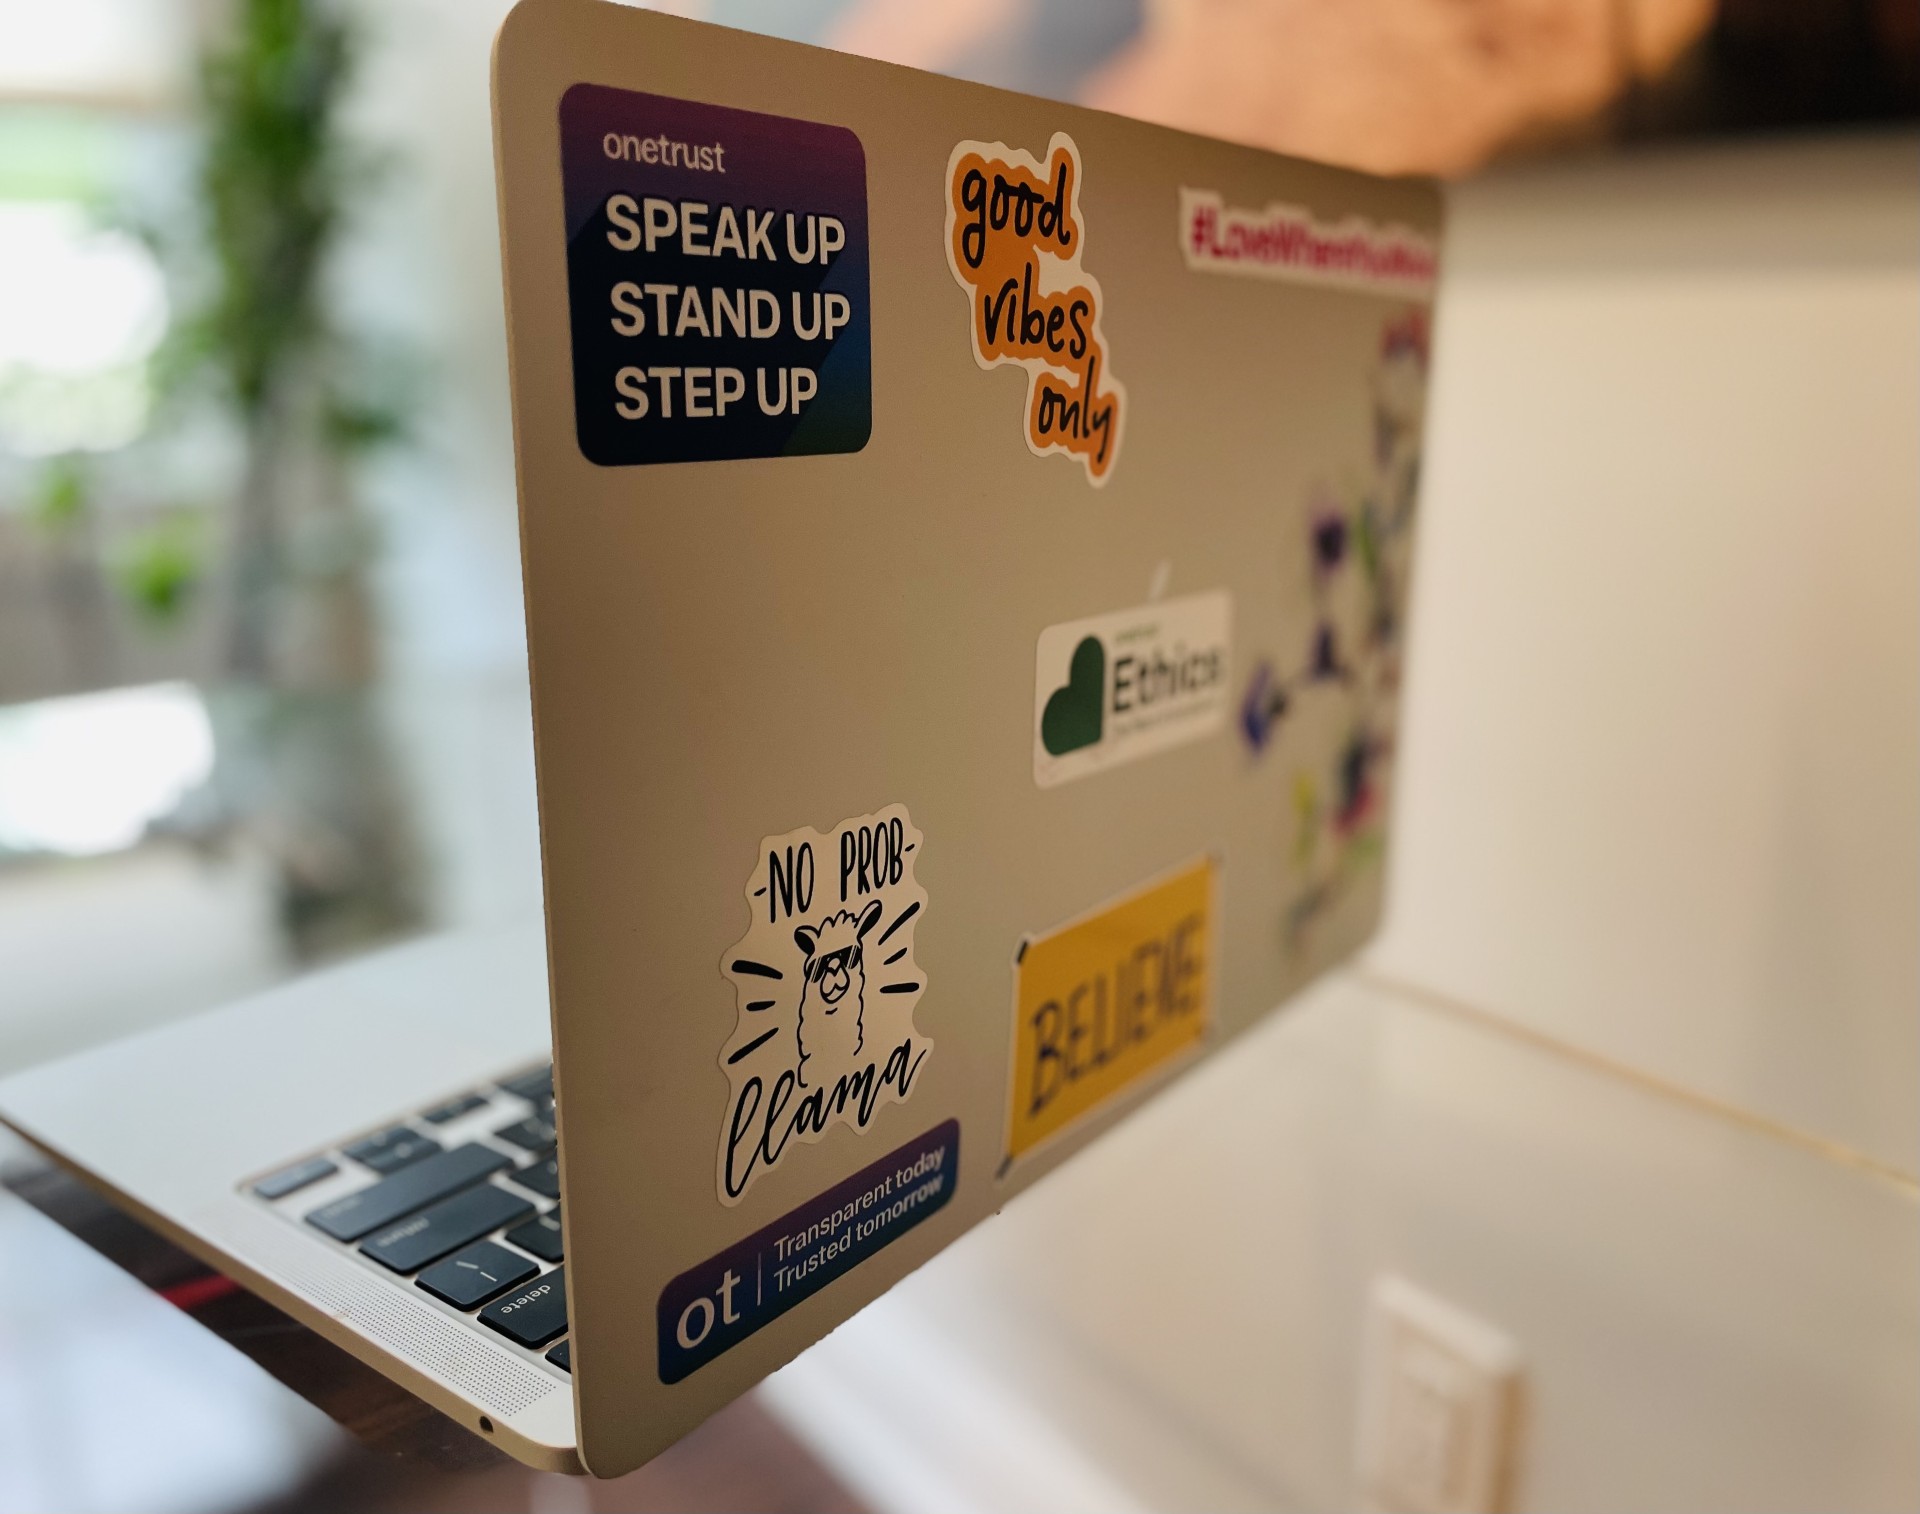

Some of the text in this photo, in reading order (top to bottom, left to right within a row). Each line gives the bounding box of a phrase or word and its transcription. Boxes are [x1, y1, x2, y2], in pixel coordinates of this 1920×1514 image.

[603, 132, 726, 174] onetrust
[605, 194, 846, 265] SPEAK UP
[962, 162, 1071, 269] good
[610, 281, 851, 340] STAND UP
[984, 262, 1089, 360] vibes
[614, 366, 818, 420] STEP UP
[1038, 355, 1112, 464] only
[1028, 911, 1206, 1120] BELIEVE
[725, 1038, 927, 1198] llama
[774, 1145, 945, 1262] Transparent today
[774, 1174, 944, 1293] Trusted tomorrow
[500, 1284, 551, 1314] delete
[676, 1268, 741, 1349] ot
